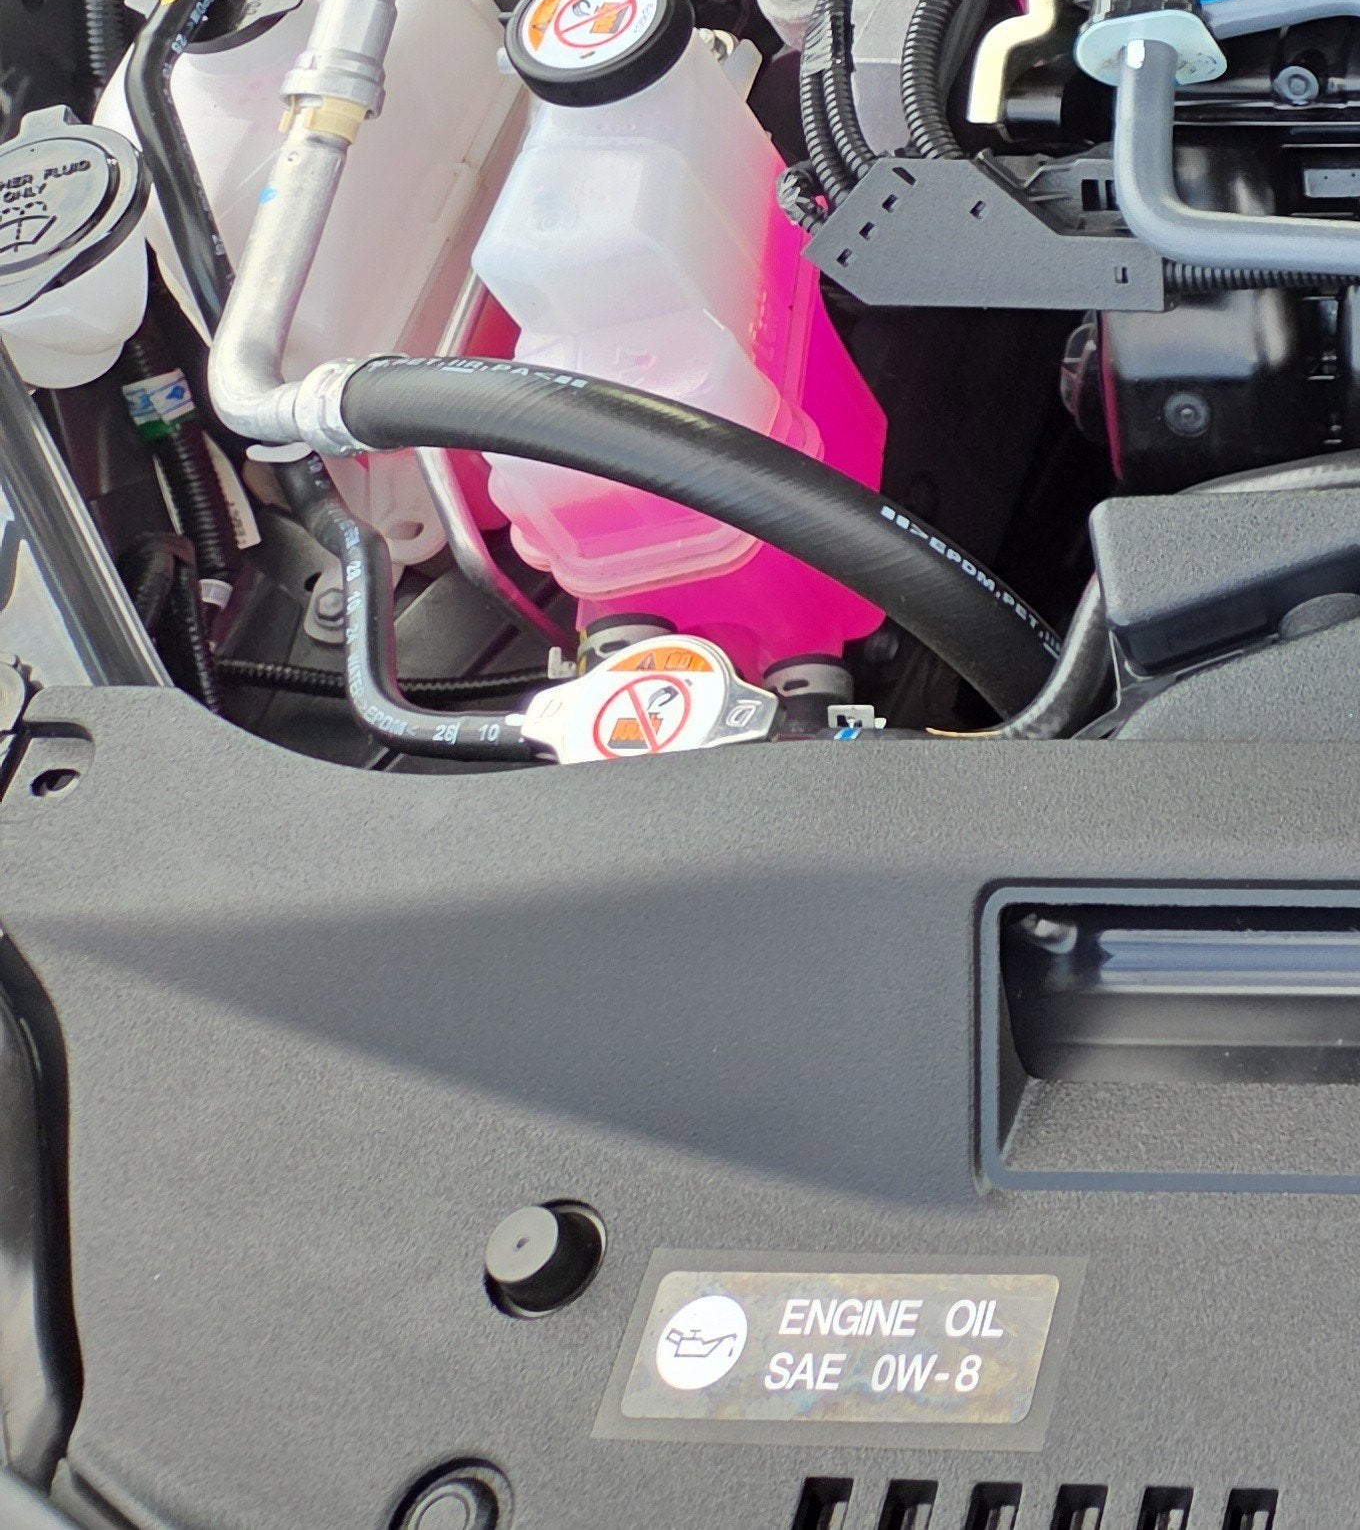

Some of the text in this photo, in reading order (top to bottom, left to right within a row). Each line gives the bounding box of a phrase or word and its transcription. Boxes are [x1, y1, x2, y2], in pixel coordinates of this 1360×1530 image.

[44, 159, 92, 181] FLUID
[778, 1298, 1003, 1338] ENGINE OIL
[764, 1352, 982, 1393] SAE 0W-8
